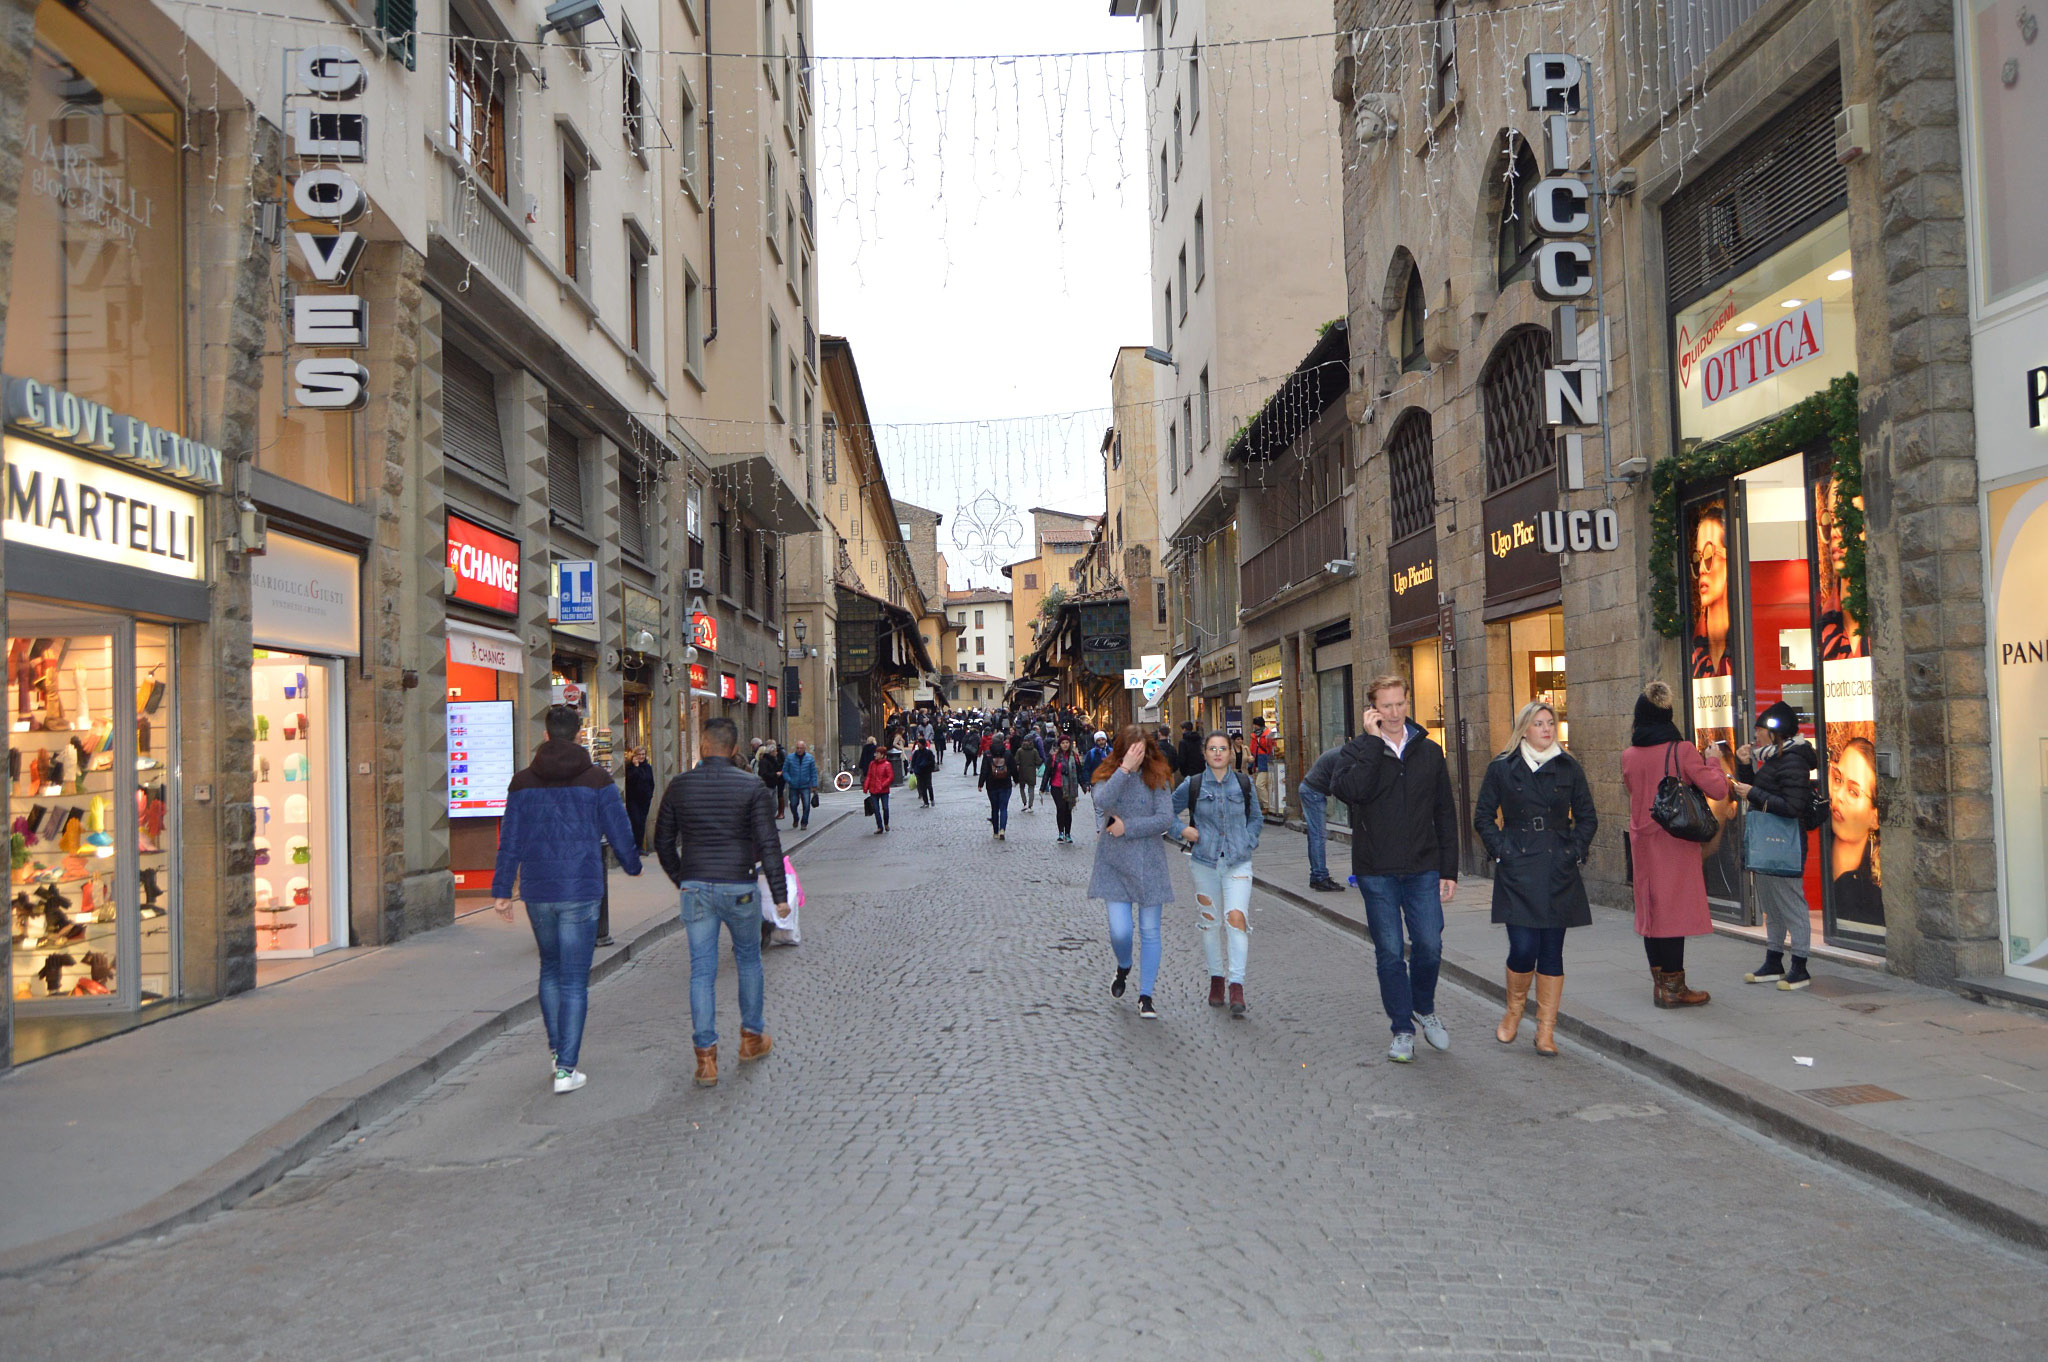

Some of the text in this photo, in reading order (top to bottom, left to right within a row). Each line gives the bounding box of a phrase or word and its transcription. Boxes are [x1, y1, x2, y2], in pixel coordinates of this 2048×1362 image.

[32, 167, 136, 249] glove factory
[294, 45, 368, 411] GLOVES
[1526, 53, 1599, 490] PICCINI
[1704, 310, 1820, 402] OTTICA
[26, 378, 223, 486] GLOVE FACTORY
[4, 462, 195, 563] MARTELLI
[1537, 508, 1619, 554] UGO
[460, 544, 519, 593] CHANGE
[1490, 530, 1512, 558] Ugo
[562, 563, 590, 603] T
[1393, 559, 1433, 596] Ugo Piccini
[689, 568, 707, 643] BAR
[478, 648, 505, 665] CHANGE
[2002, 639, 2048, 665] PAN
[1824, 680, 1850, 698] oberto
